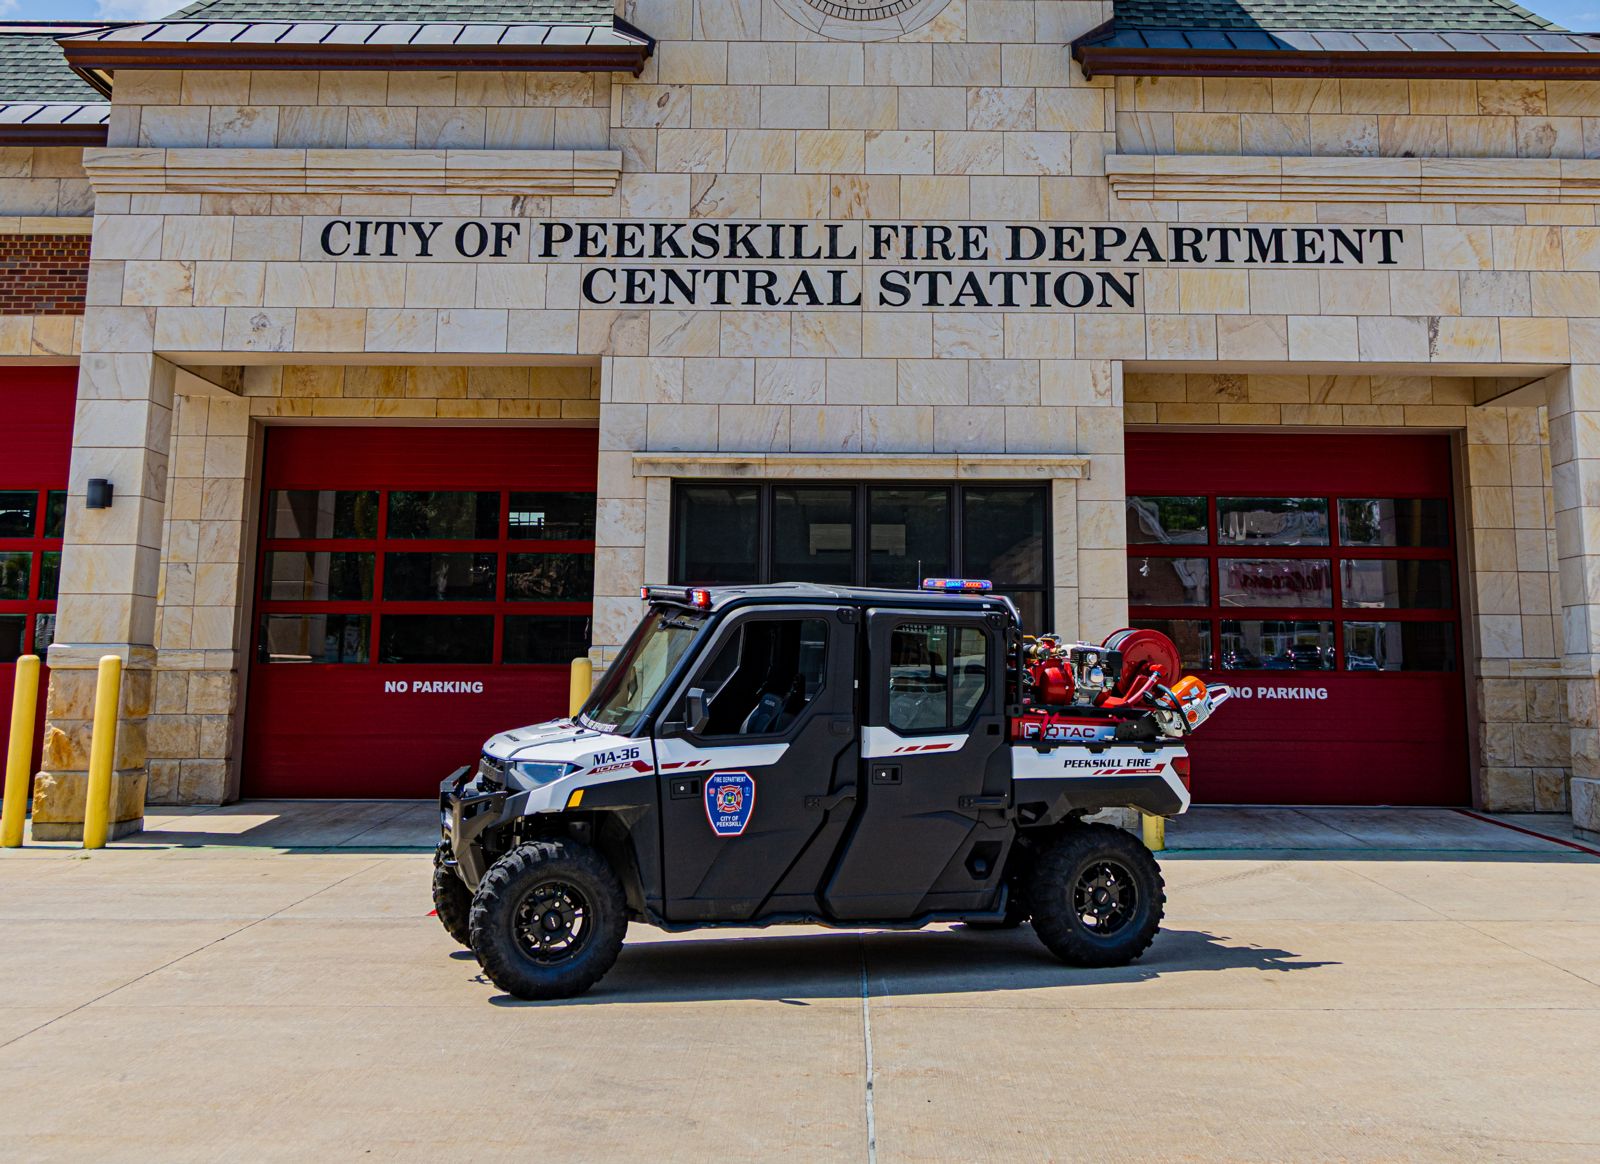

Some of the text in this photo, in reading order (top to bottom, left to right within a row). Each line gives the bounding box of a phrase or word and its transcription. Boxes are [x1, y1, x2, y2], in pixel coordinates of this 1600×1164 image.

[321, 221, 1404, 264] CITY OF PEEKSKILL FIRE DEPARTMENT
[583, 268, 1139, 308] CENTRAL STATION
[384, 681, 484, 693] NO PARKING
[1229, 686, 1328, 699] NO PARKING
[593, 747, 640, 765] MA-36
[1063, 758, 1151, 768] PEEKSKILL FIRE
